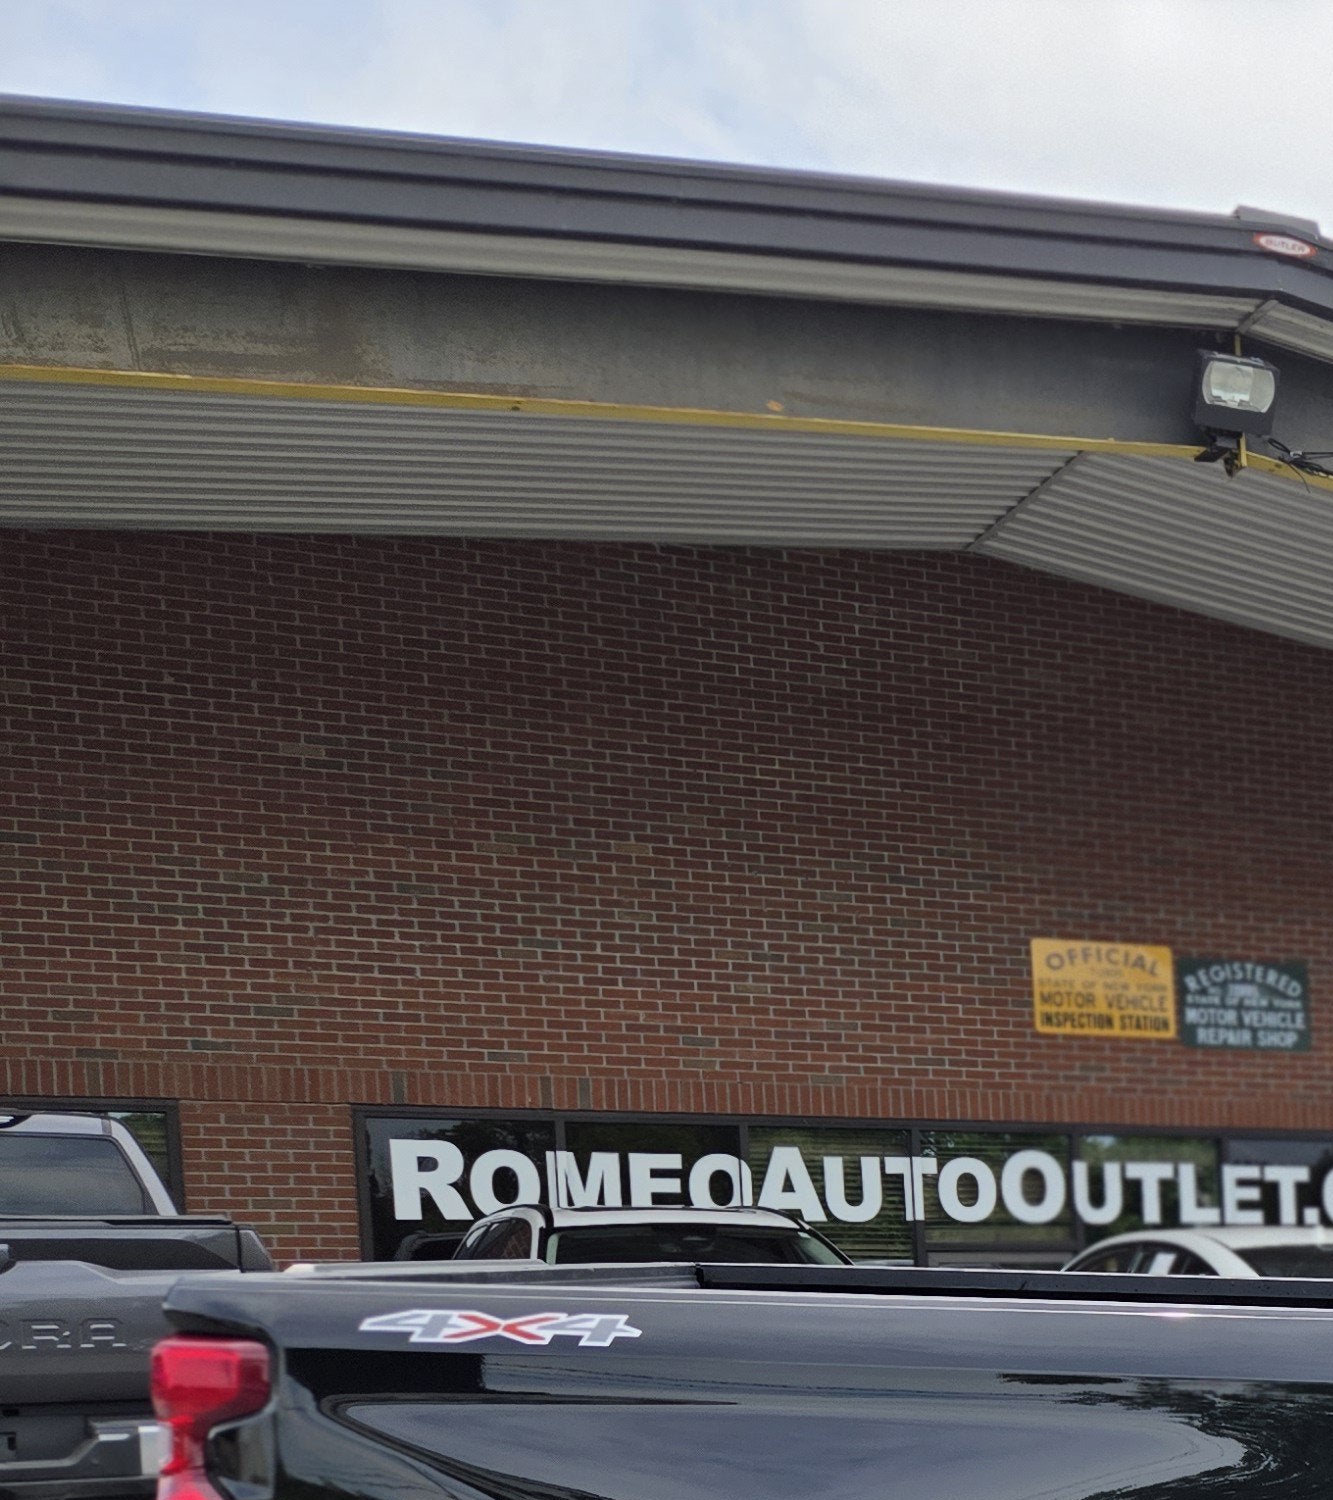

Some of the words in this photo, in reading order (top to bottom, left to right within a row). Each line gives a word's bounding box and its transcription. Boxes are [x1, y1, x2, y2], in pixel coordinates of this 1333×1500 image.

[1045, 946, 1159, 976] OFFICIAL
[1184, 963, 1301, 997] REGISTERED
[1039, 991, 1096, 1008] MOTOR
[1104, 994, 1168, 1012] VEHICLE
[1040, 1011, 1114, 1030] INSPECTION
[1119, 1015, 1170, 1032] STATION
[1185, 1007, 1238, 1025] MOTOR
[1241, 1010, 1305, 1029] VEHICLE
[1197, 1028, 1251, 1045] REPAIR
[1257, 1030, 1298, 1048] SHOP
